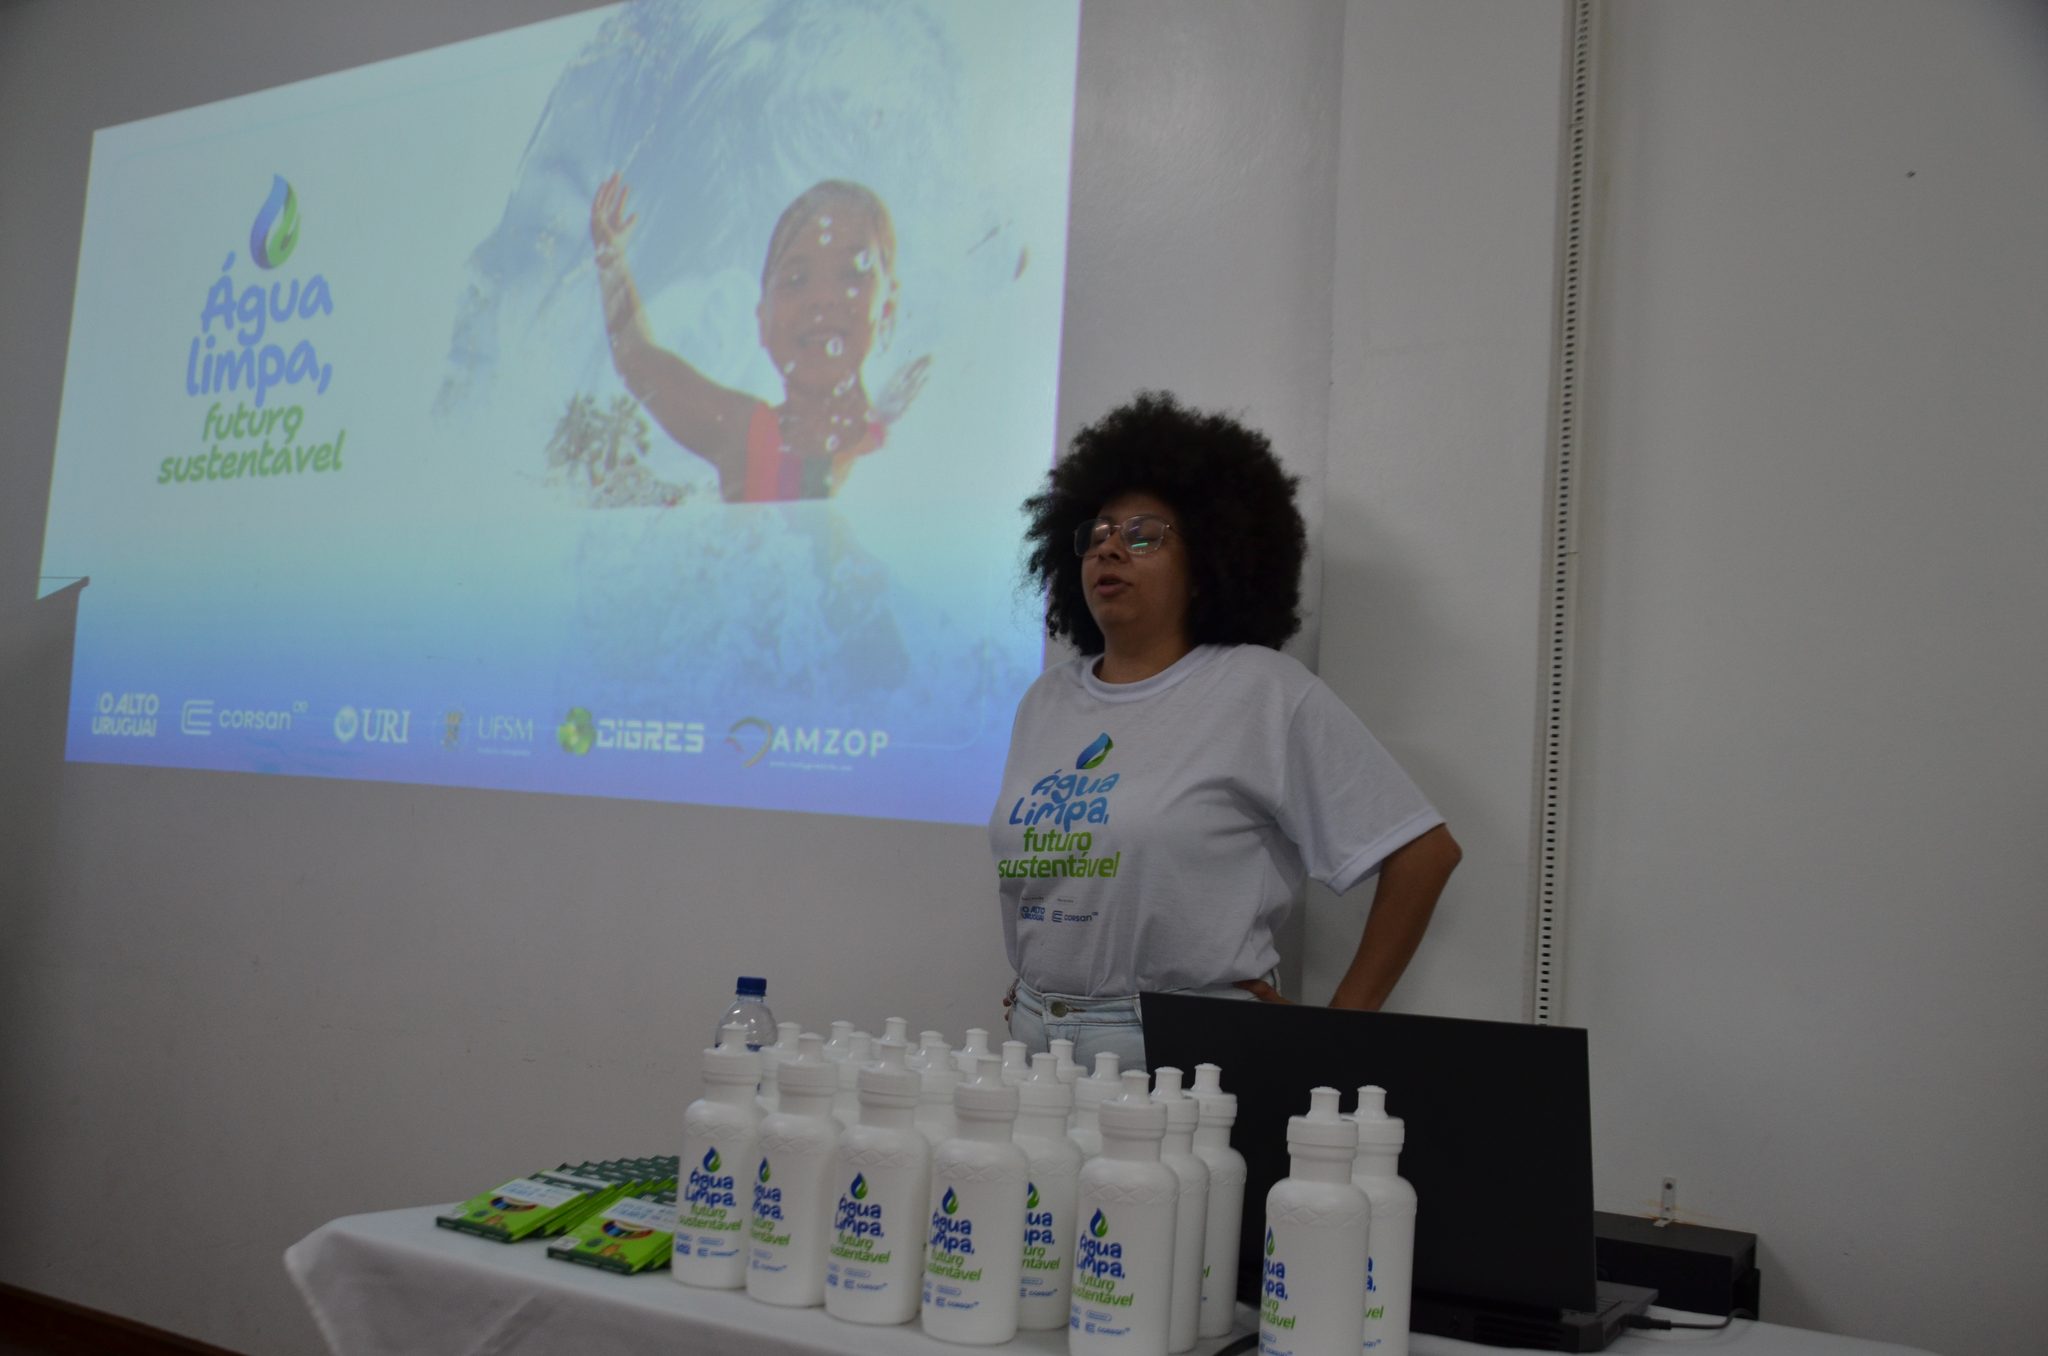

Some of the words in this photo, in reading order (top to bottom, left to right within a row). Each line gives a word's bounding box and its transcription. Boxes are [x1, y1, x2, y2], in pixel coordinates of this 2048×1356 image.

[201, 250, 333, 347] Água
[203, 402, 304, 444] futuro
[157, 428, 346, 484] sustentável
[115, 692, 160, 715] ALTO
[92, 716, 157, 737] URUGUAI
[362, 708, 410, 743] URI
[478, 715, 533, 743] UFSM
[771, 725, 889, 759] AMZOP
[1031, 768, 1121, 805] Água
[1023, 826, 1092, 853] futuro
[998, 851, 1121, 879] sustentável
[690, 1166, 734, 1191] Água
[839, 1193, 881, 1219] Água
